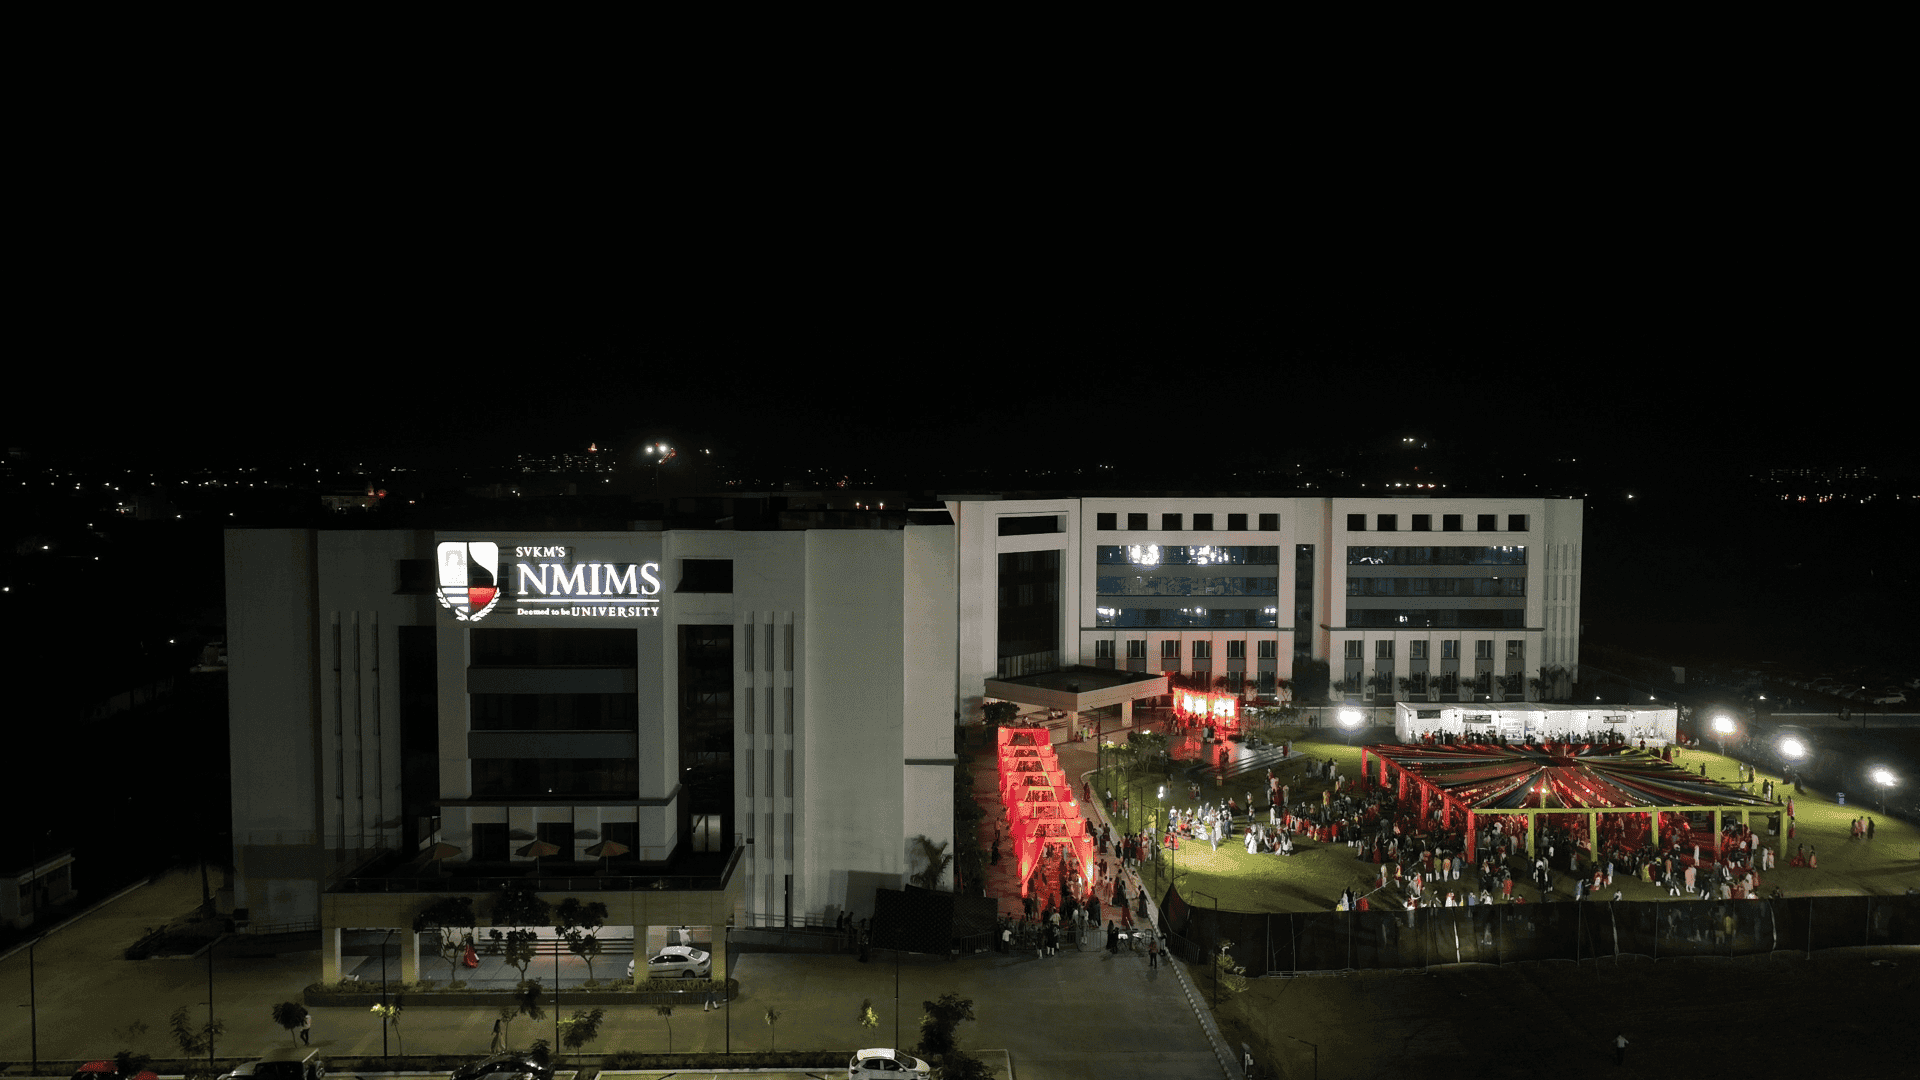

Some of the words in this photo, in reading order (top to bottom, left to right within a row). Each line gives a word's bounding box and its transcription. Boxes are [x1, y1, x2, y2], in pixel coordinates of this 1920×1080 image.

[515, 546, 566, 558] SVKM'S
[516, 562, 661, 596] NMIMS
[517, 608, 549, 616] Deemed
[551, 608, 559, 616] to
[560, 607, 570, 616] be
[571, 606, 660, 618] UNIVERSITY
